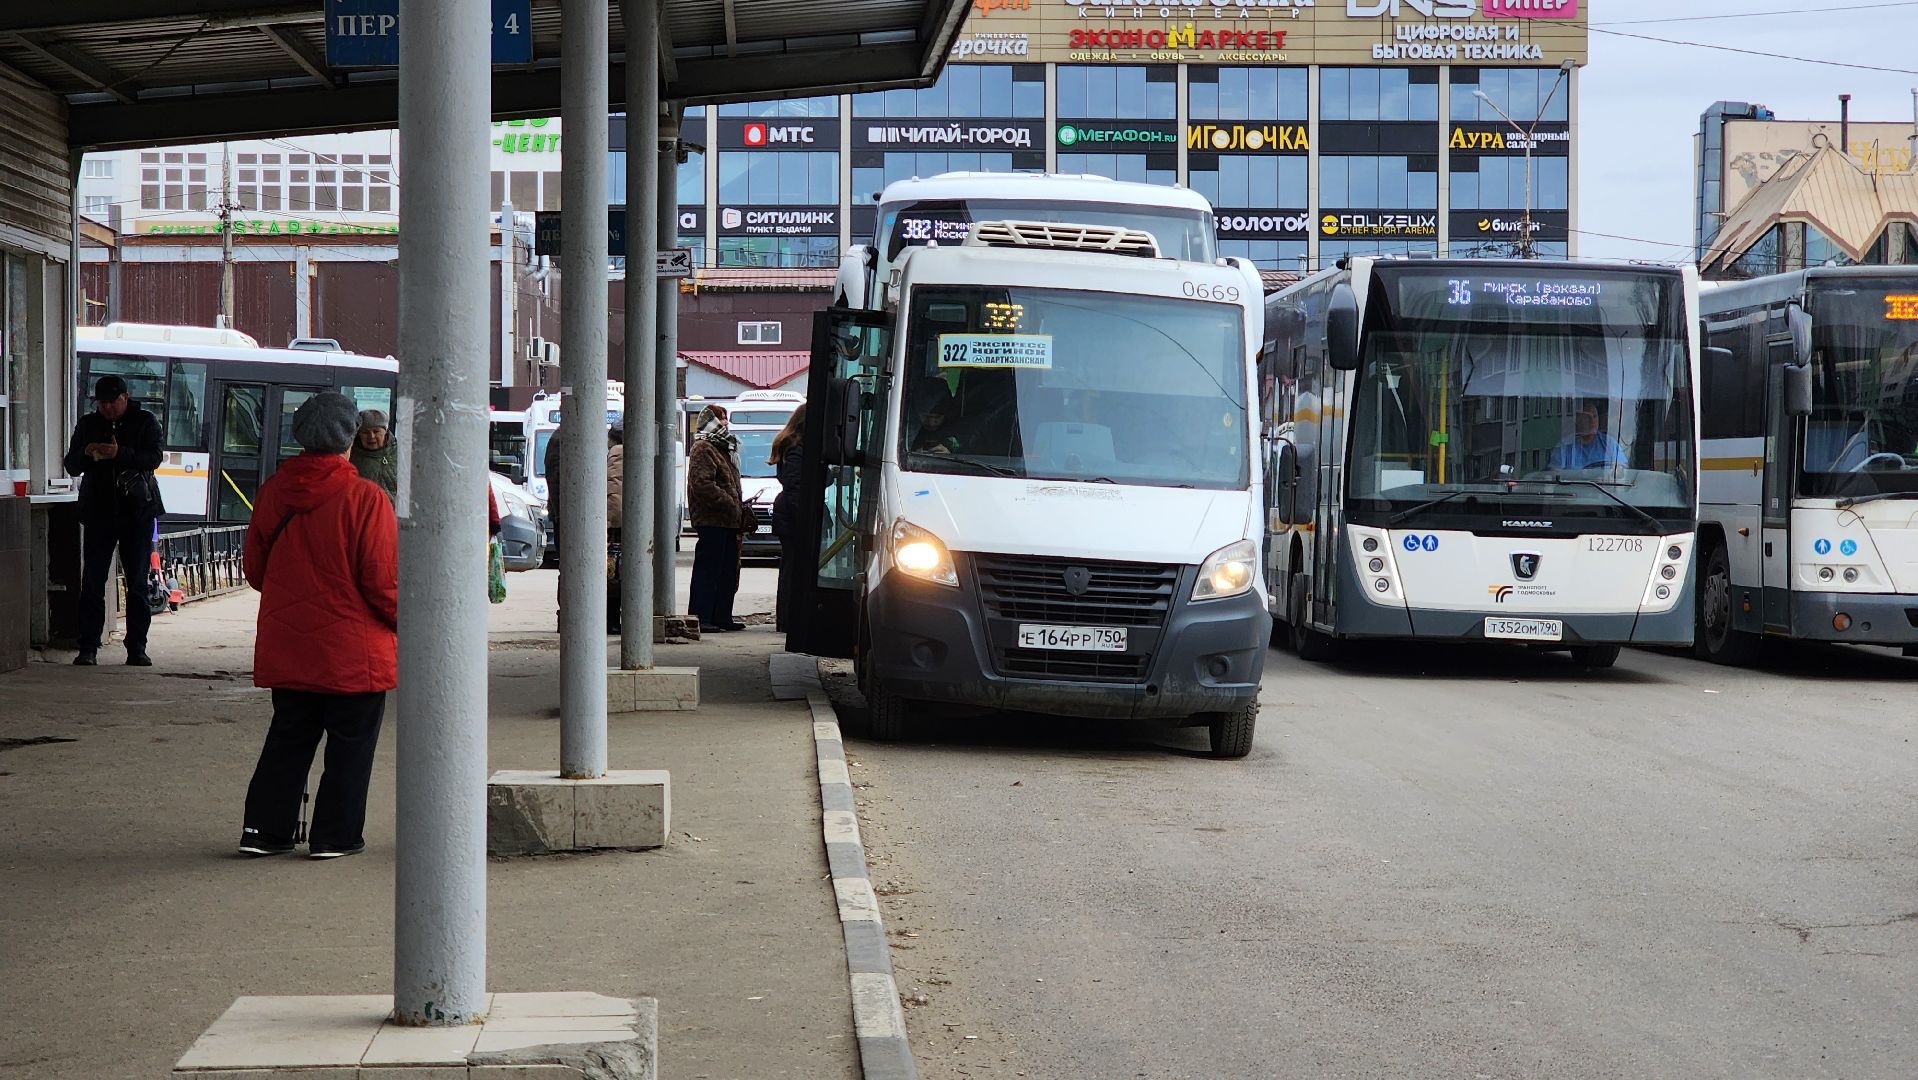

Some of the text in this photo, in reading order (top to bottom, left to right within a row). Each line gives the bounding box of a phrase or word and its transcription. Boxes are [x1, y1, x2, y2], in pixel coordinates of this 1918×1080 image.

[336, 15, 400, 36] ПЕР
[504, 13, 520, 34] 4
[1069, 22, 1288, 49] ЭКОНОМАРКЕТ
[1396, 25, 1519, 42] ЦИФРОВАЯ И
[951, 39, 1027, 59] ерочка
[1372, 44, 1543, 59] БЫТОВАЯ ТЕХНИКА
[1070, 52, 1288, 61] ОДЕЖДА ОБУВЬ АКСЕССУАРЫ
[769, 126, 814, 143] МТС
[901, 124, 1031, 147] ЧИТАЙ-ГОРОД
[1187, 125, 1309, 150] ИГОЛОЧКА
[493, 133, 560, 153] -ЦЕНТ
[746, 212, 834, 224] СИТИЛИНК
[1221, 213, 1309, 231] ЗОЛОТОЙ
[776, 226, 811, 234] ВЫДАЧИ
[902, 218, 931, 238] 382
[935, 220, 975, 230] Ногинс
[1340, 226, 1436, 234] CYBER SPORT ARENA
[1492, 219, 1540, 231] билан
[935, 229, 969, 238] Москв
[1183, 281, 1239, 302] 0669
[1448, 280, 1471, 305] 36
[1536, 282, 1601, 294] (вокзал)
[1506, 293, 1592, 306] Карабаново
[972, 341, 1046, 349] ЭКСПРЕСС
[943, 343, 968, 362] 322
[972, 348, 1046, 356] НОГИНСК
[985, 355, 1045, 364] ПАРТИЗАНСКАЯ
[1502, 520, 1553, 528] KAMAZ
[1588, 538, 1643, 552] 122708
[1540, 622, 1557, 632] 790
[1096, 630, 1121, 643] 750
